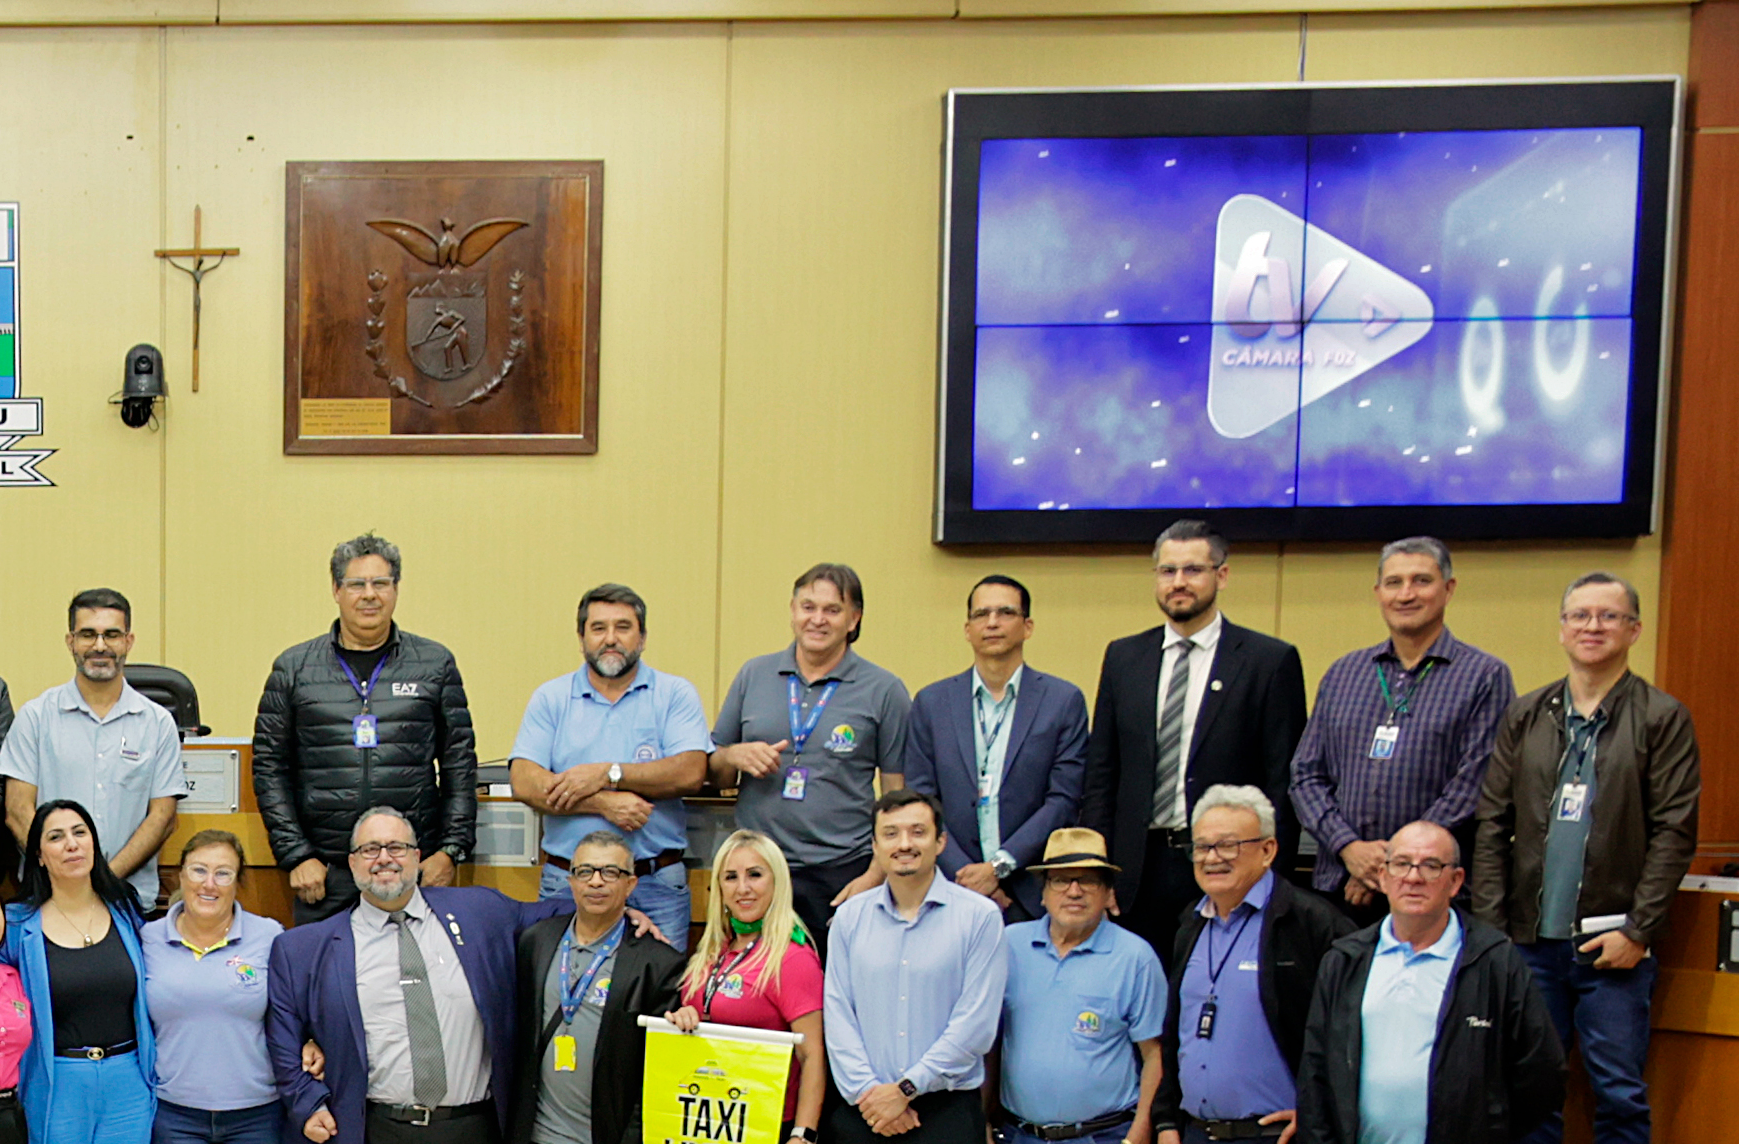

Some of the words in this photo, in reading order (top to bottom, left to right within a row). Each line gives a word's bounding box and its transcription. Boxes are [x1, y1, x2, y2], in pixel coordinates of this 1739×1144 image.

[1222, 345, 1315, 367] CÂMARA
[392, 682, 418, 693] EA7
[678, 1096, 747, 1143] TAXI
